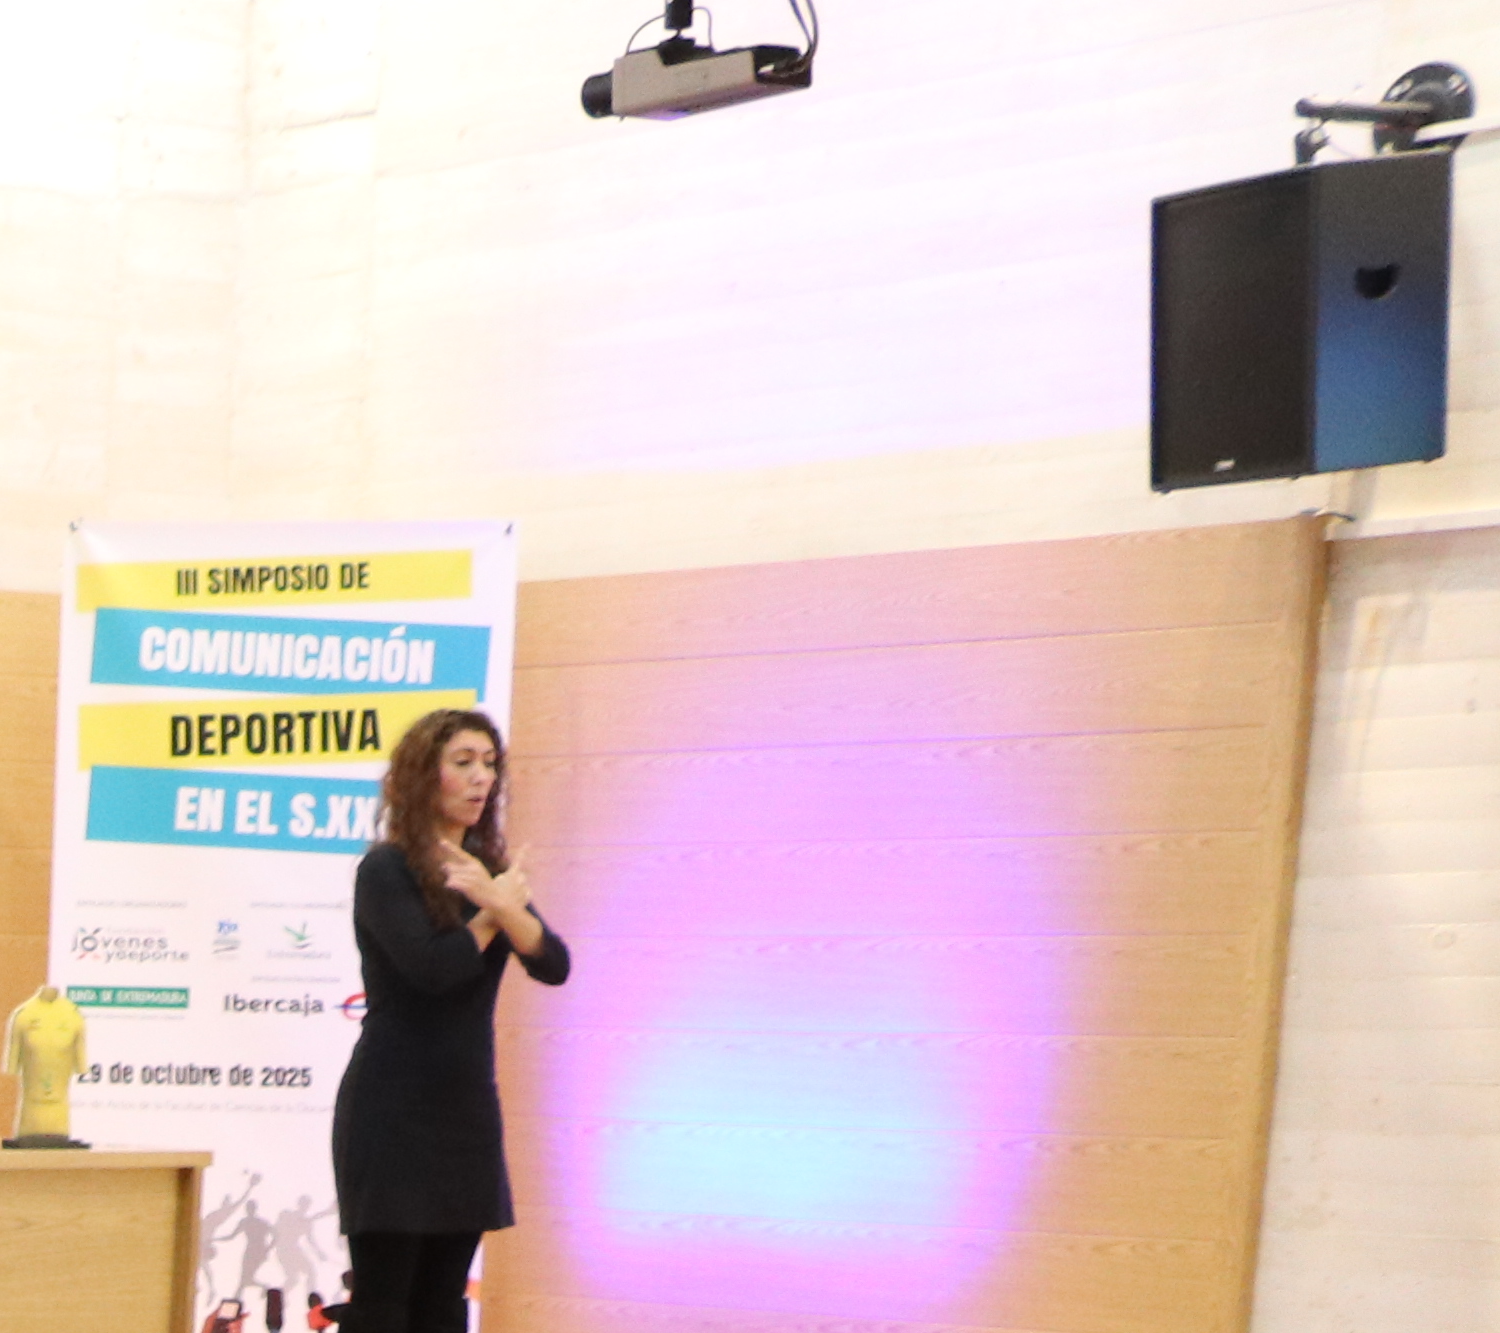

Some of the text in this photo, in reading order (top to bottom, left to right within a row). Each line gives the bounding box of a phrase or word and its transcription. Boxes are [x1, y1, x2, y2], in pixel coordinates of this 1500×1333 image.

[177, 562, 370, 596] III SIMPOSIO DE
[138, 626, 435, 684] COMUNICACIÓN
[170, 709, 381, 758] DEPORTIVA
[174, 786, 226, 832] EN
[234, 790, 278, 835] EL
[224, 993, 324, 1016] Ibercaja
[109, 1062, 132, 1084] de
[141, 1063, 222, 1086] octubre
[229, 1065, 255, 1087] de
[261, 1067, 313, 1088] 2025
